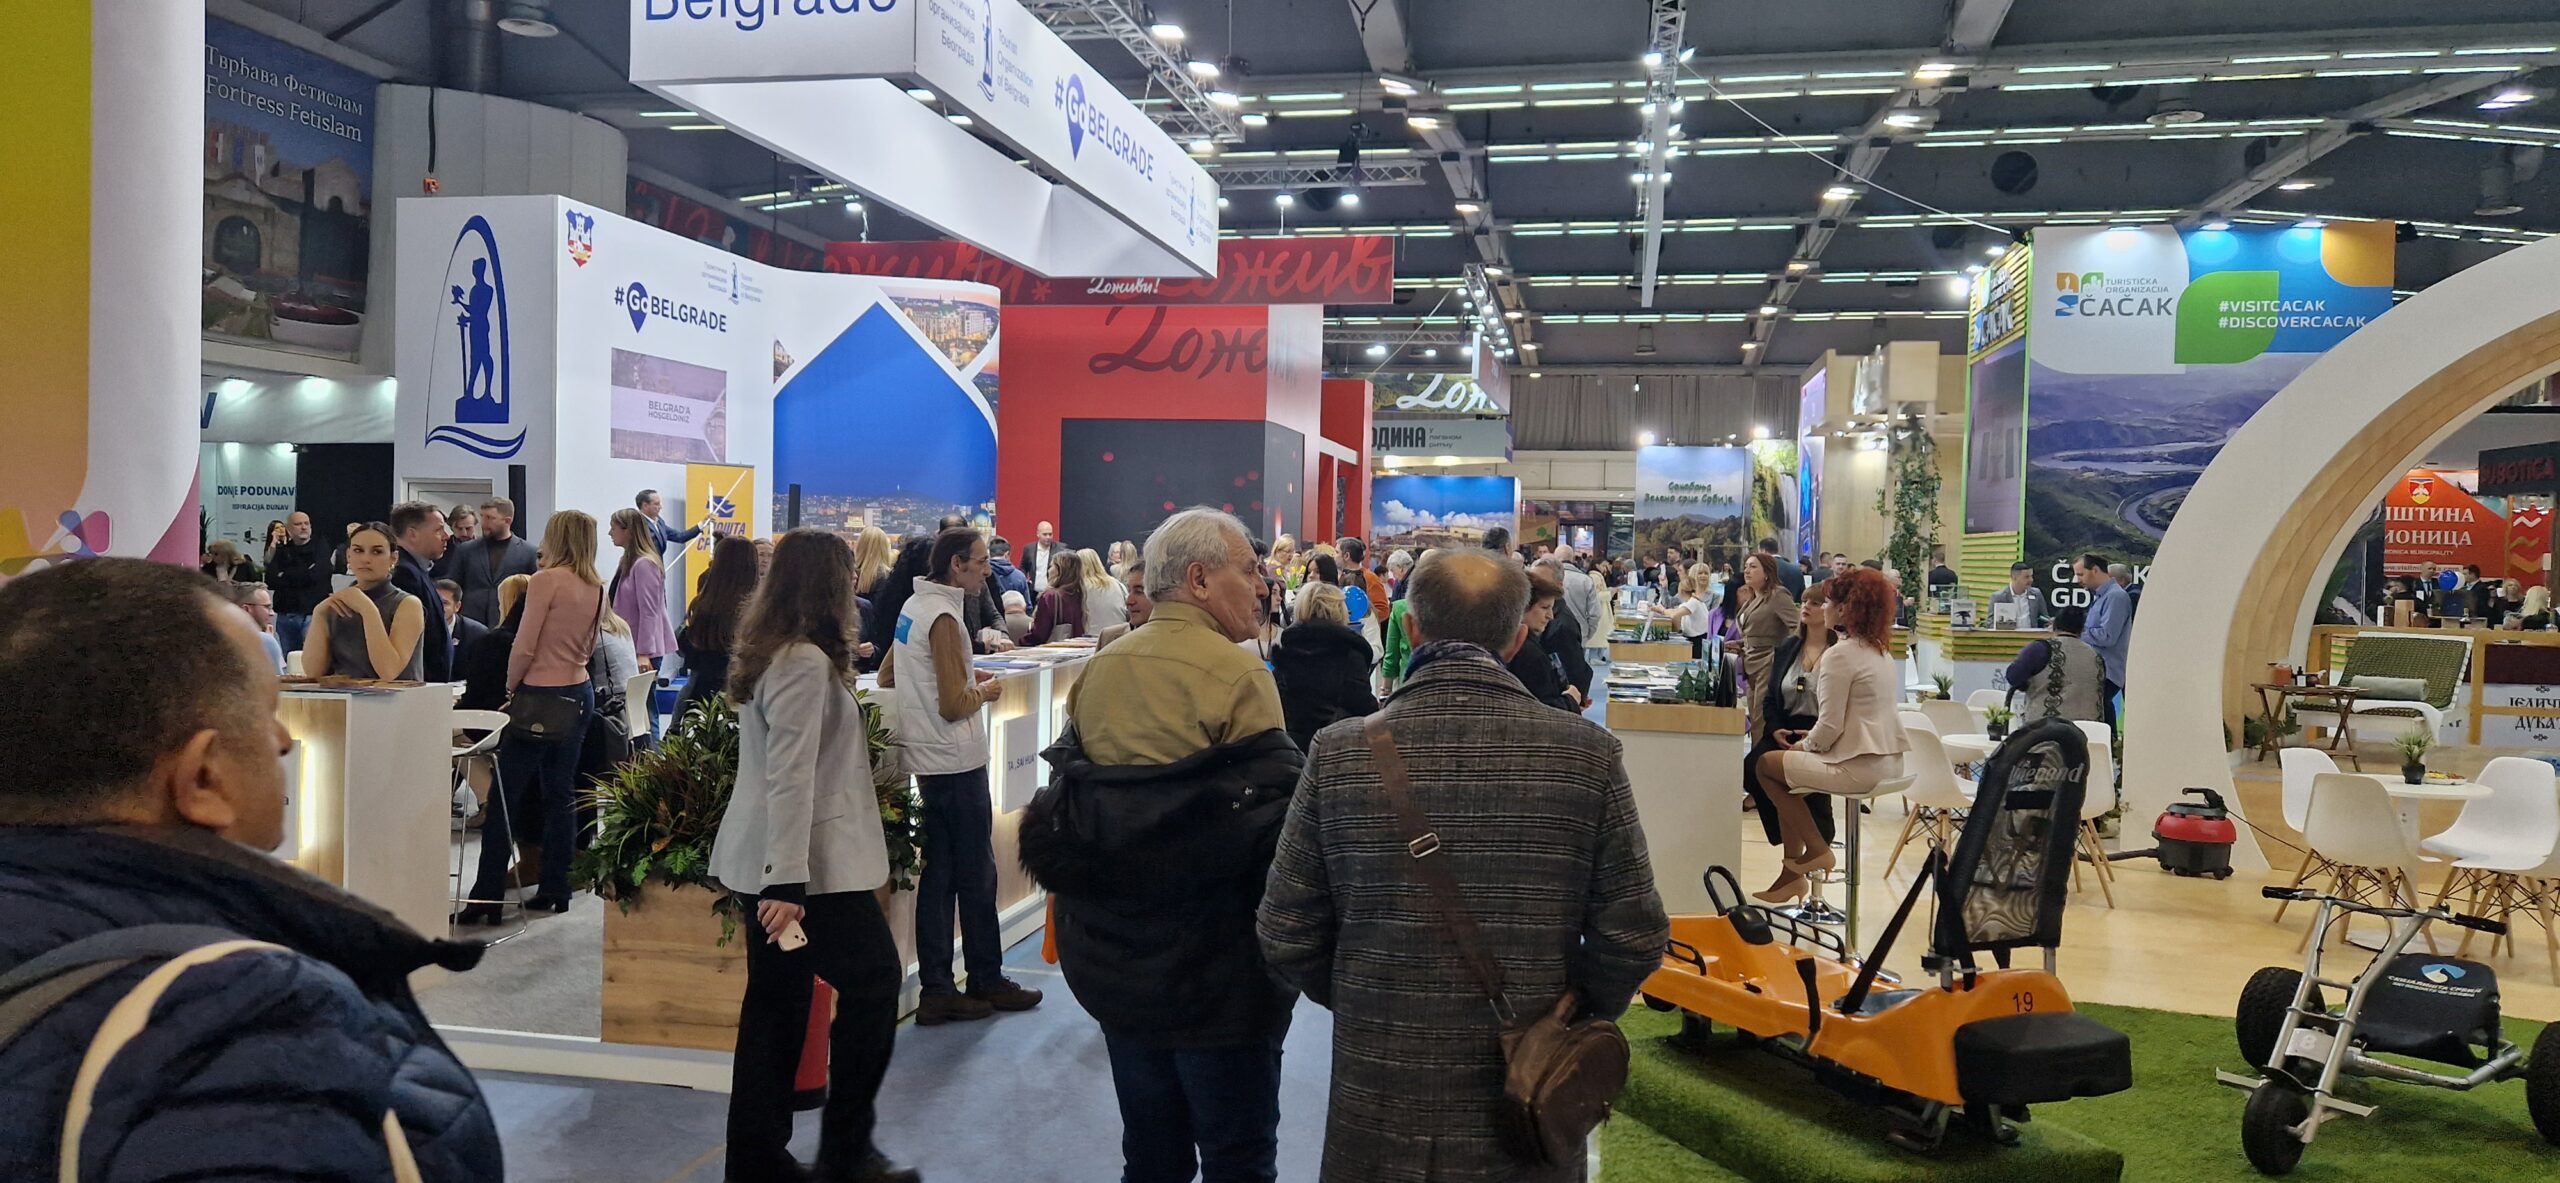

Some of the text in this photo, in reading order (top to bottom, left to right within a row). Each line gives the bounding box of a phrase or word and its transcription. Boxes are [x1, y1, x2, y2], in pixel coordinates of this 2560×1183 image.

[206, 44, 364, 116] Тврђава Фетислам
[206, 75, 363, 142] Fortress Fetislam
[2105, 286, 2169, 294] ORGANIZACIJA
[2080, 293, 2174, 317] ČAČAK
[2219, 299, 2326, 313] #VISITCACAK
[2218, 315, 2367, 329] #DISCOVERCACAK
[1371, 427, 1426, 451] ДИНА
[2515, 715, 2560, 732] ДУКА
[2013, 991, 2033, 1012] 19
